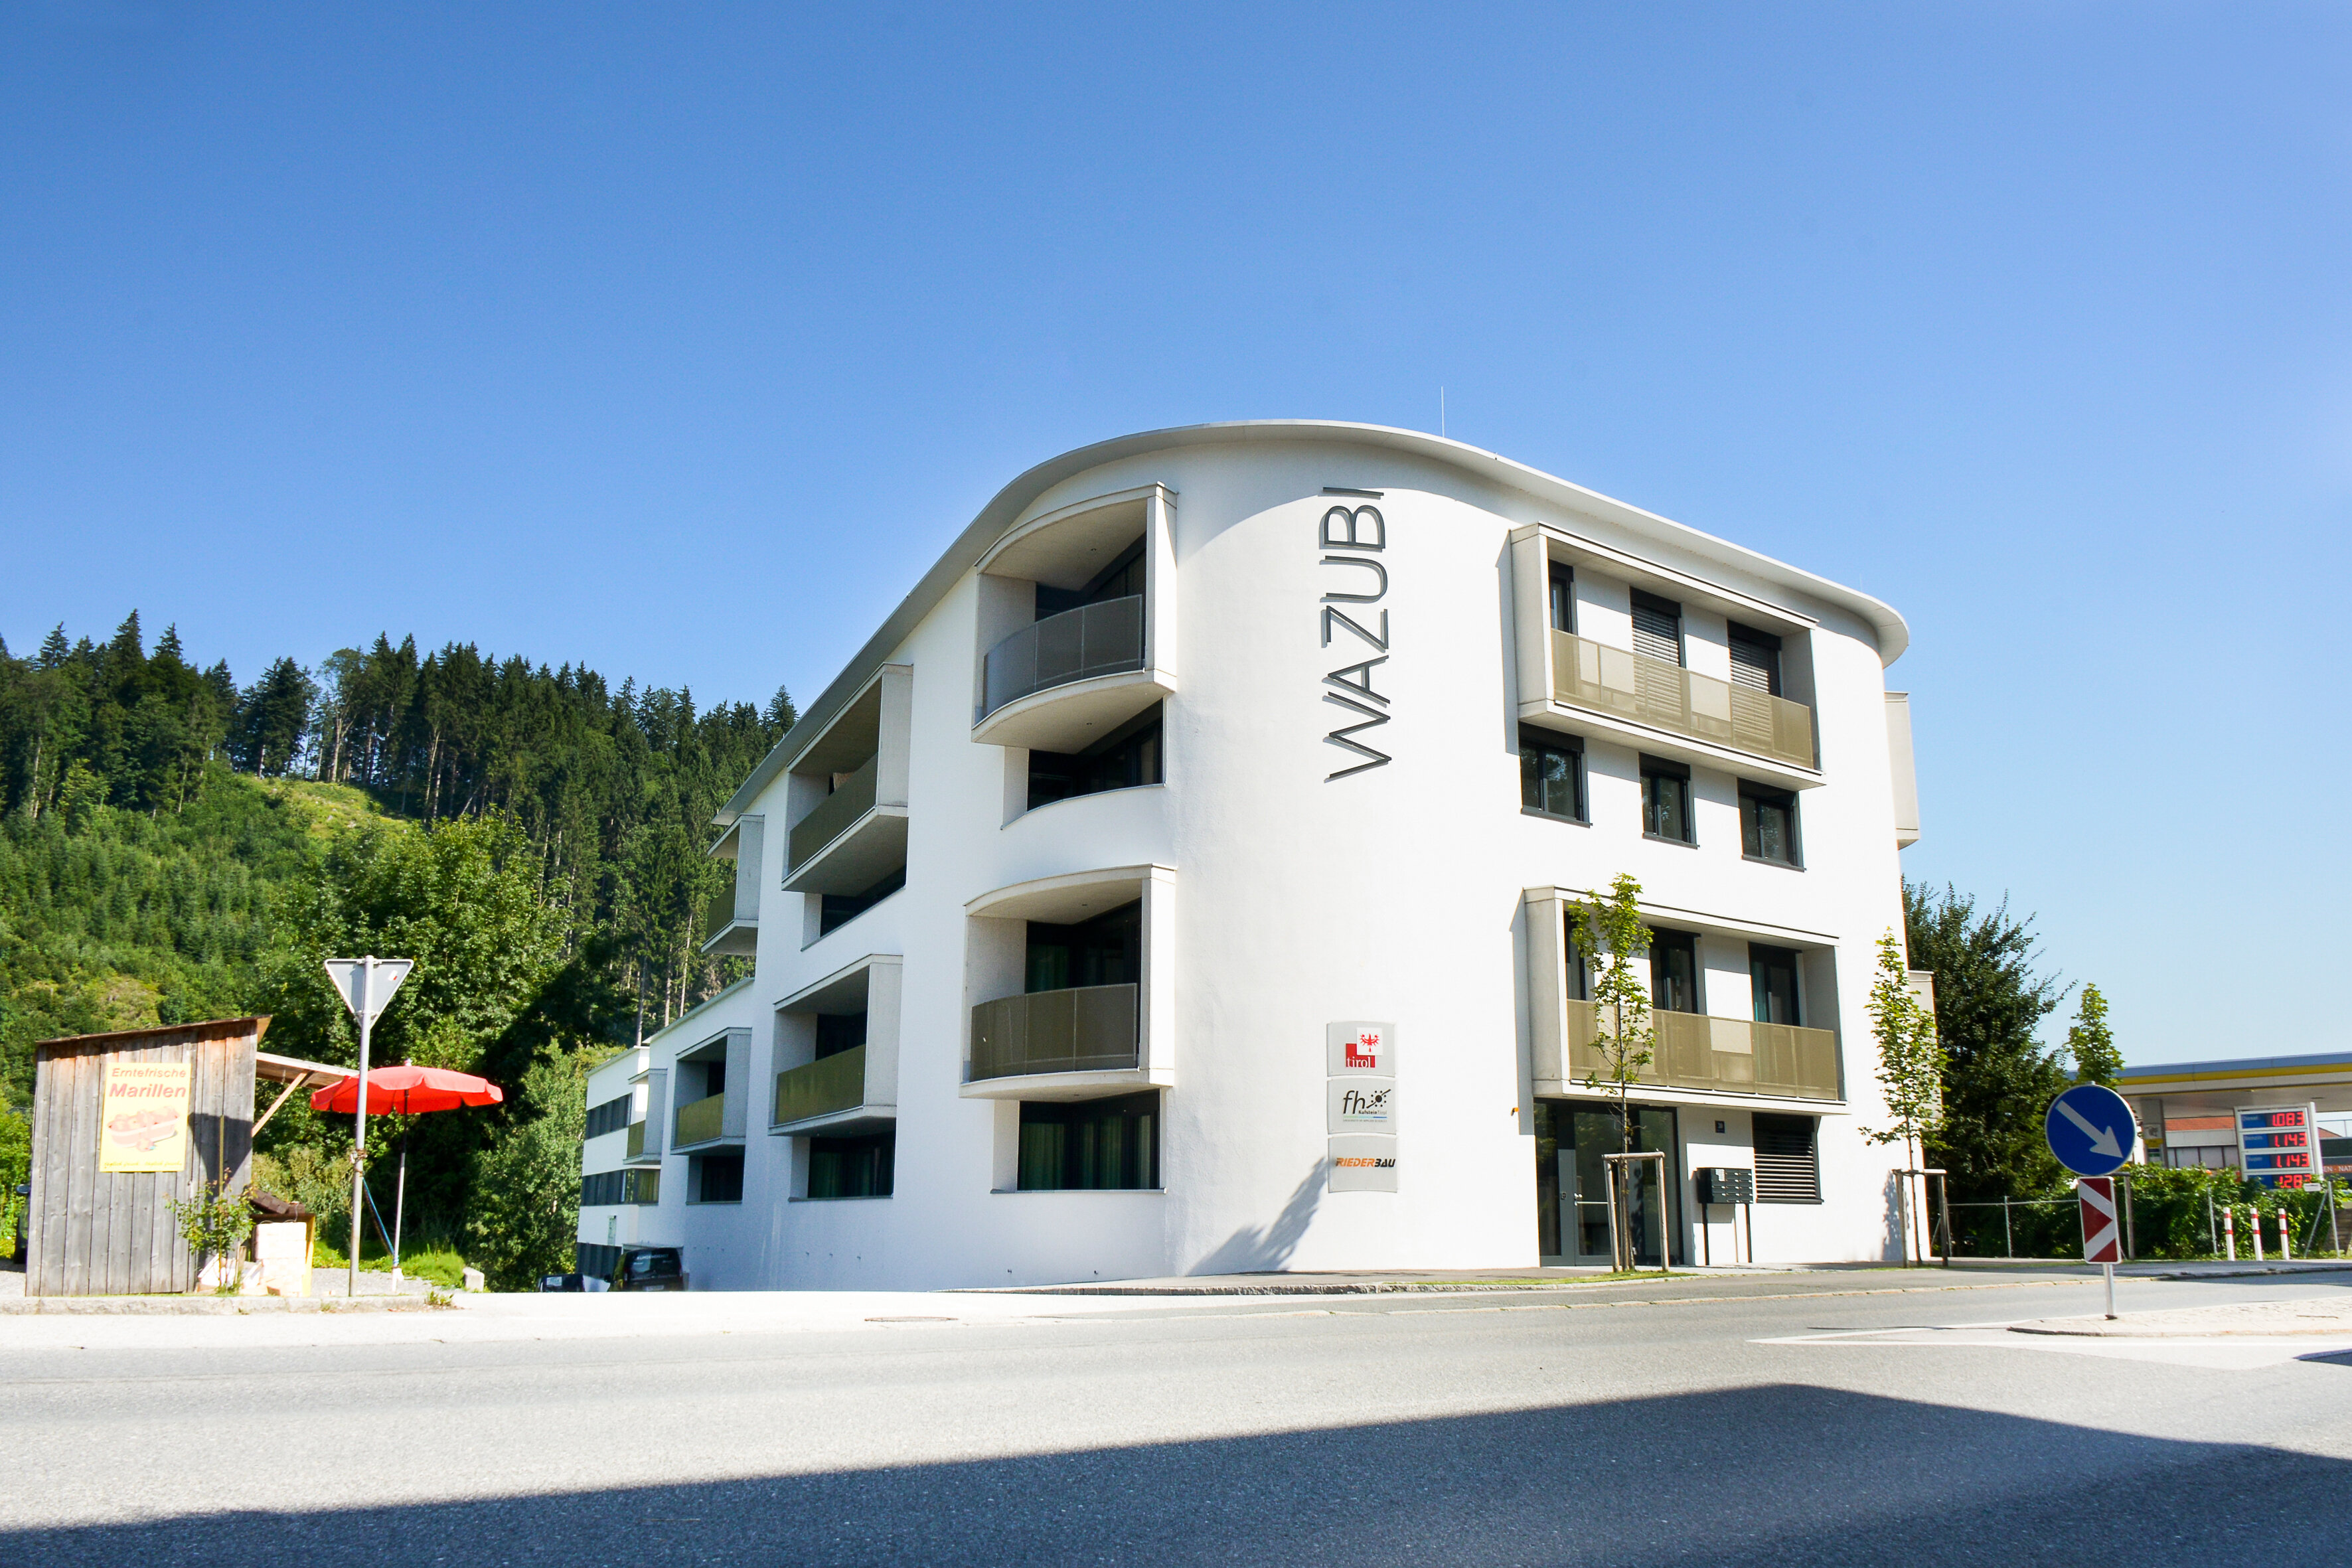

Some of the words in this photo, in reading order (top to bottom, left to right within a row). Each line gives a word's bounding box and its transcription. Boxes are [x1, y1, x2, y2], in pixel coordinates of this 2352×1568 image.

[1321, 485, 1392, 779] WAZUBI
[1346, 1056, 1371, 1068] tirol
[112, 1067, 187, 1078] Erntefrische
[109, 1083, 187, 1098] Marillen
[1343, 1090, 1366, 1114] fh
